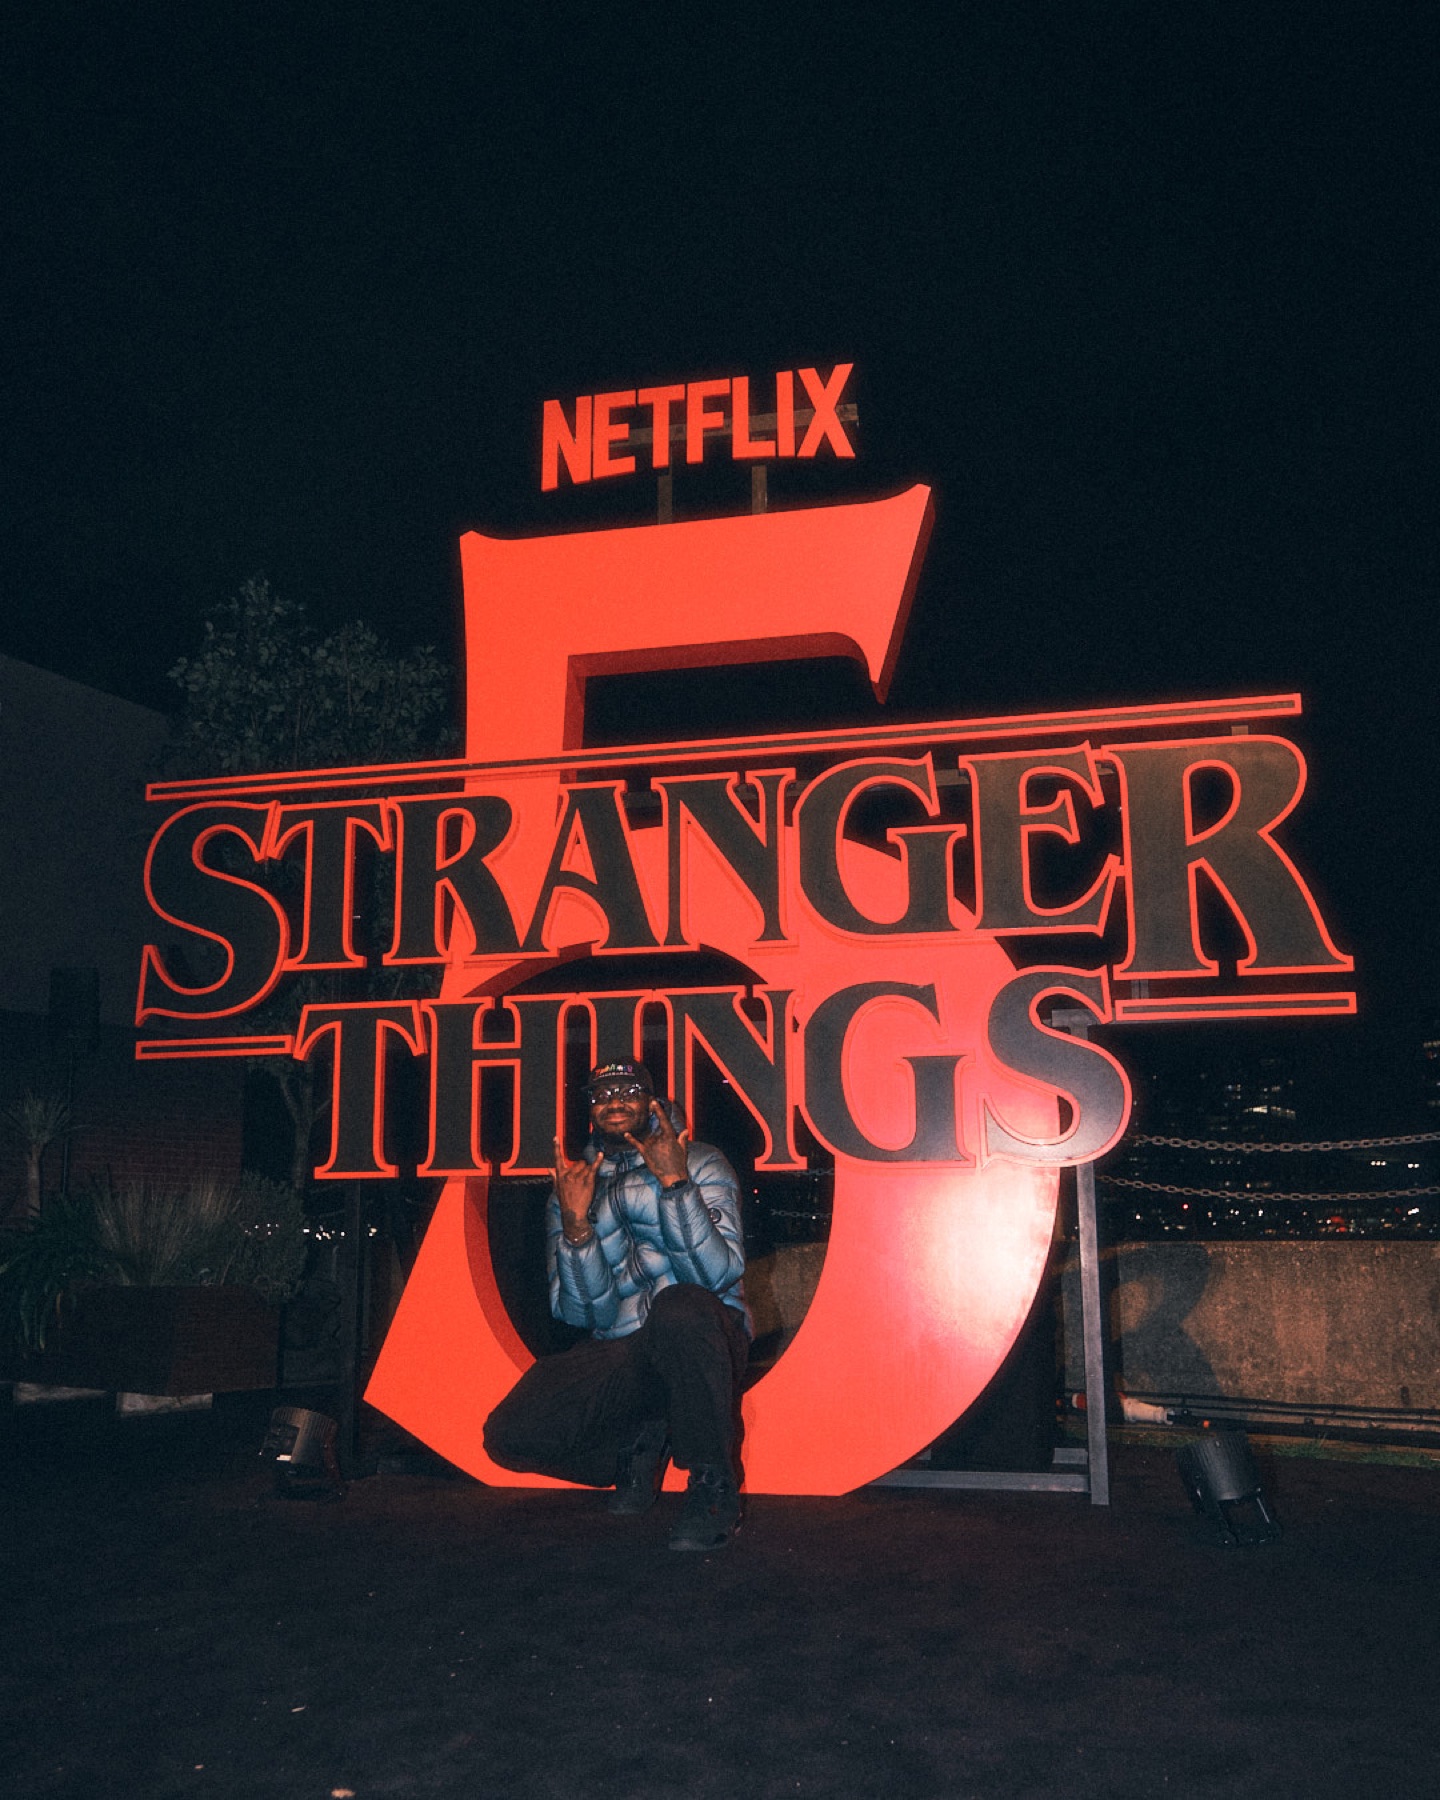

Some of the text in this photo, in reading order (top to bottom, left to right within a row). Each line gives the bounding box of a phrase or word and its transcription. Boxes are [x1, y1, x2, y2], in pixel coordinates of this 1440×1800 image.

[541, 363, 856, 492] NETFLIX
[135, 735, 1355, 1027] STRANGER
[363, 484, 1060, 1497] 5
